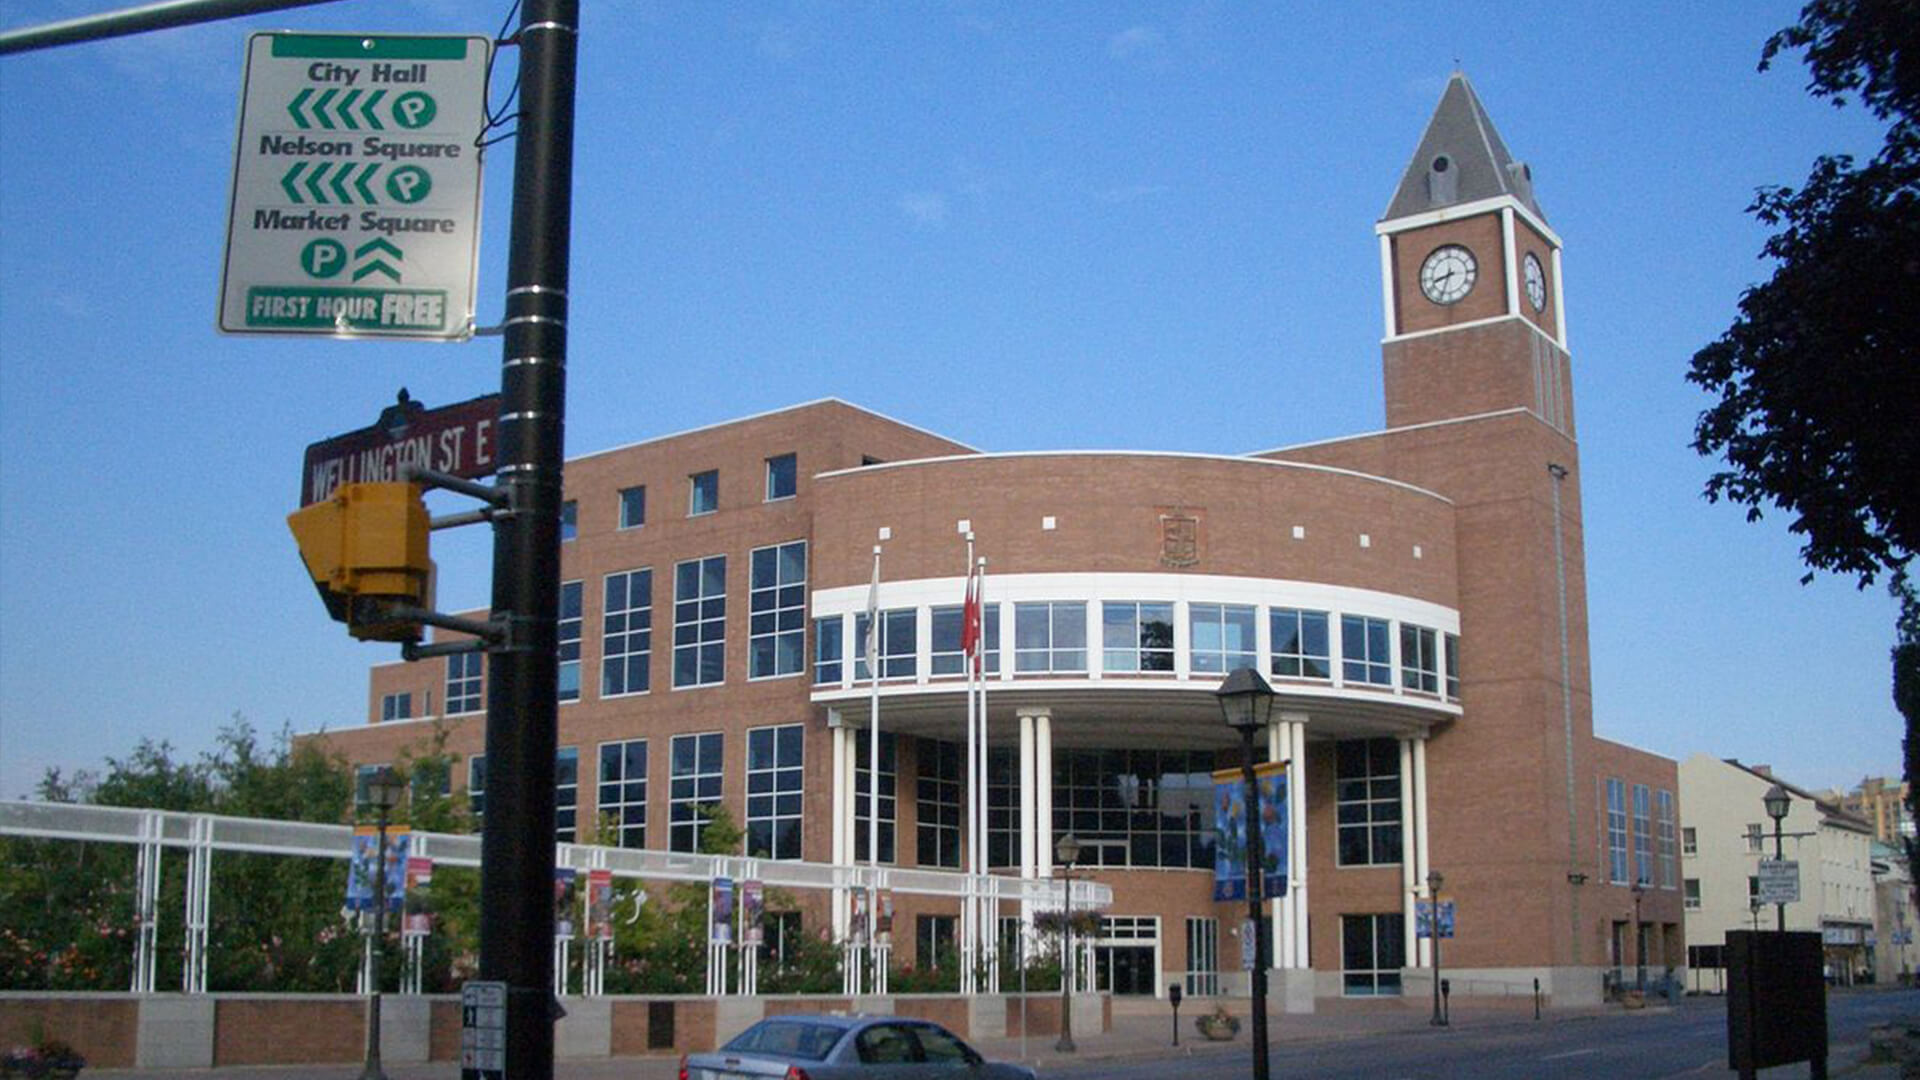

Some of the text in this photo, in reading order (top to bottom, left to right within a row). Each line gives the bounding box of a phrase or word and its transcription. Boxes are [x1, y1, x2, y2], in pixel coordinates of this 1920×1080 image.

[308, 62, 427, 85] City Hall
[400, 98, 425, 125] P
[259, 135, 461, 161] Nelson Square
[394, 171, 420, 200] P
[253, 210, 455, 235] Market Square
[312, 245, 337, 273] P
[252, 293, 443, 326] FIRST HOUR FREE
[438, 426, 465, 473] ST
[476, 419, 491, 465] E
